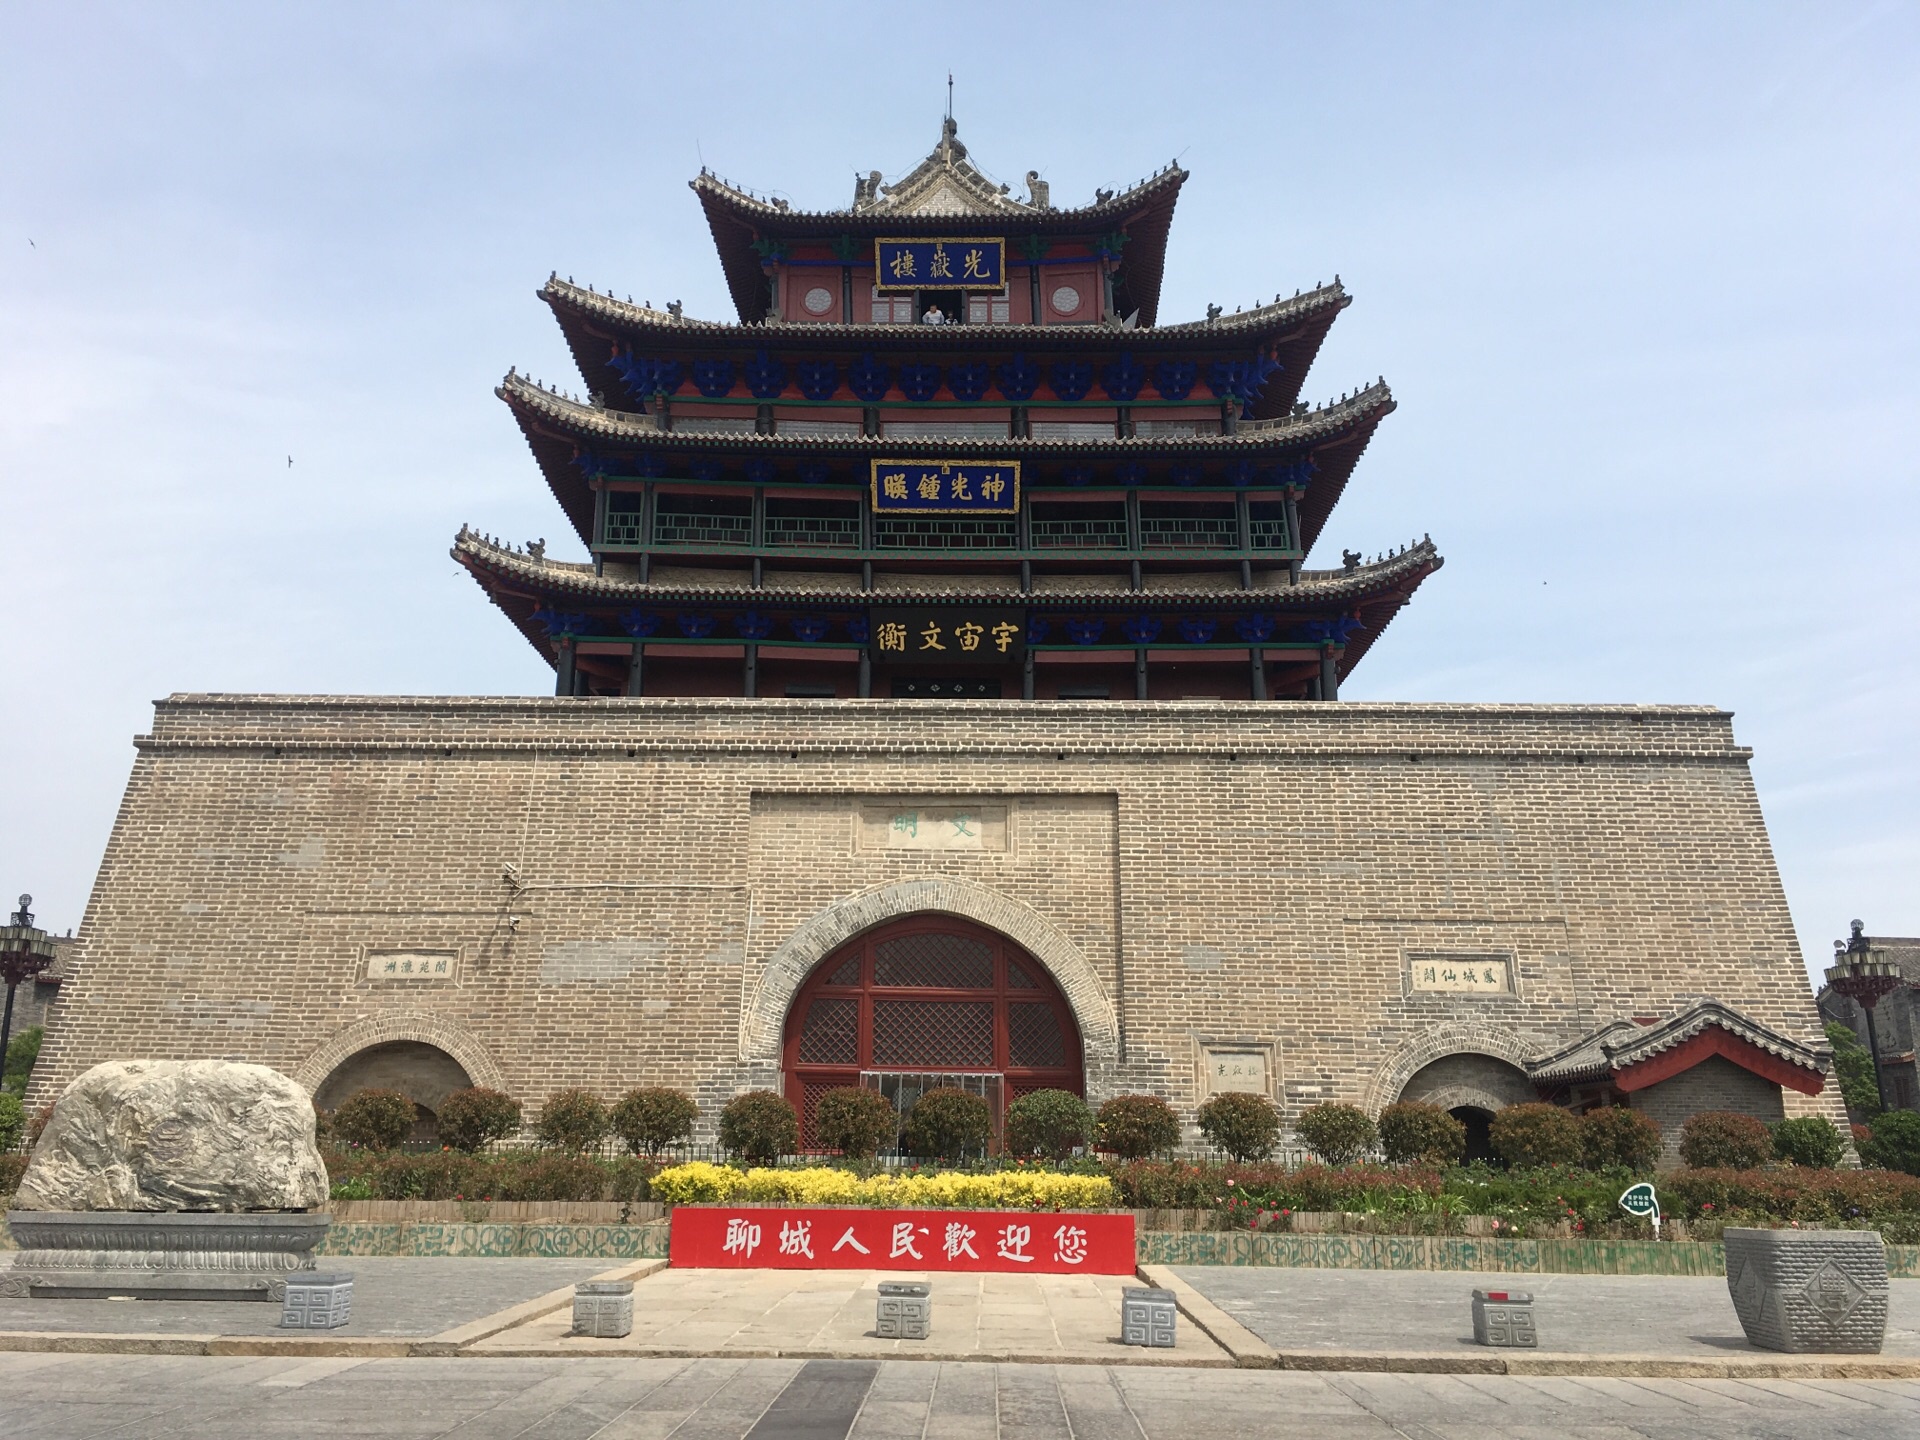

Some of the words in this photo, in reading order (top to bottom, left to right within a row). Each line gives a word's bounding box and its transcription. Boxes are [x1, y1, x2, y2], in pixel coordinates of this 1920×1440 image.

[890, 249, 991, 279] 光嶽樓
[876, 621, 1020, 653] 宇宙文衡
[893, 811, 976, 838] 文明
[722, 1218, 1088, 1265] 聊城人民歡迎您
